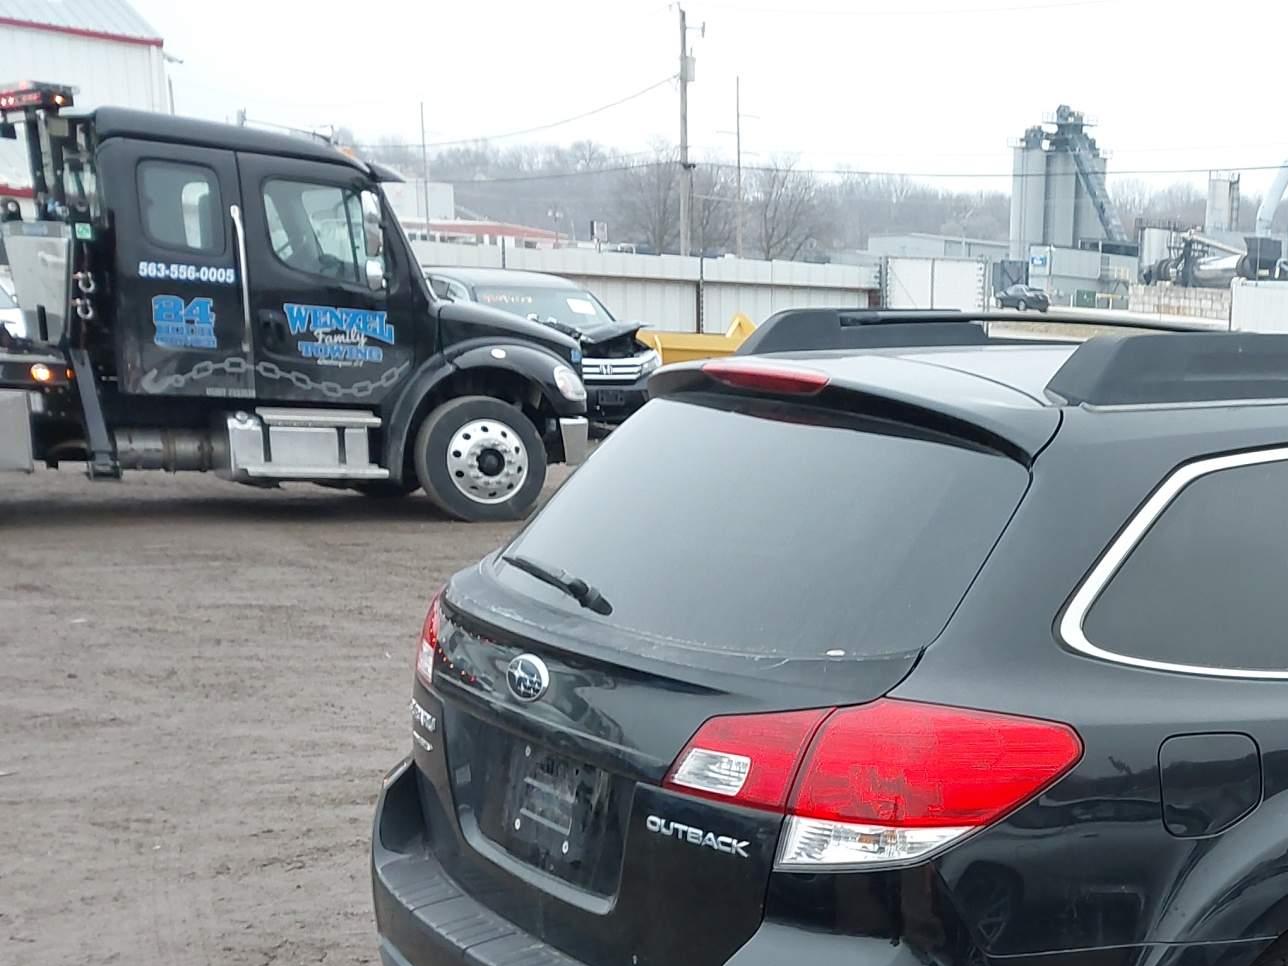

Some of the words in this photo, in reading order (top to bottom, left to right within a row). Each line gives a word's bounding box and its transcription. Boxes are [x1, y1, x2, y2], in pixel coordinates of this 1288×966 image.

[138, 261, 235, 283] 563-556-0005
[283, 303, 395, 345] WENZEL
[313, 326, 367, 347] Family
[298, 341, 383, 363] TOWING
[646, 815, 750, 858] OUTBACK
